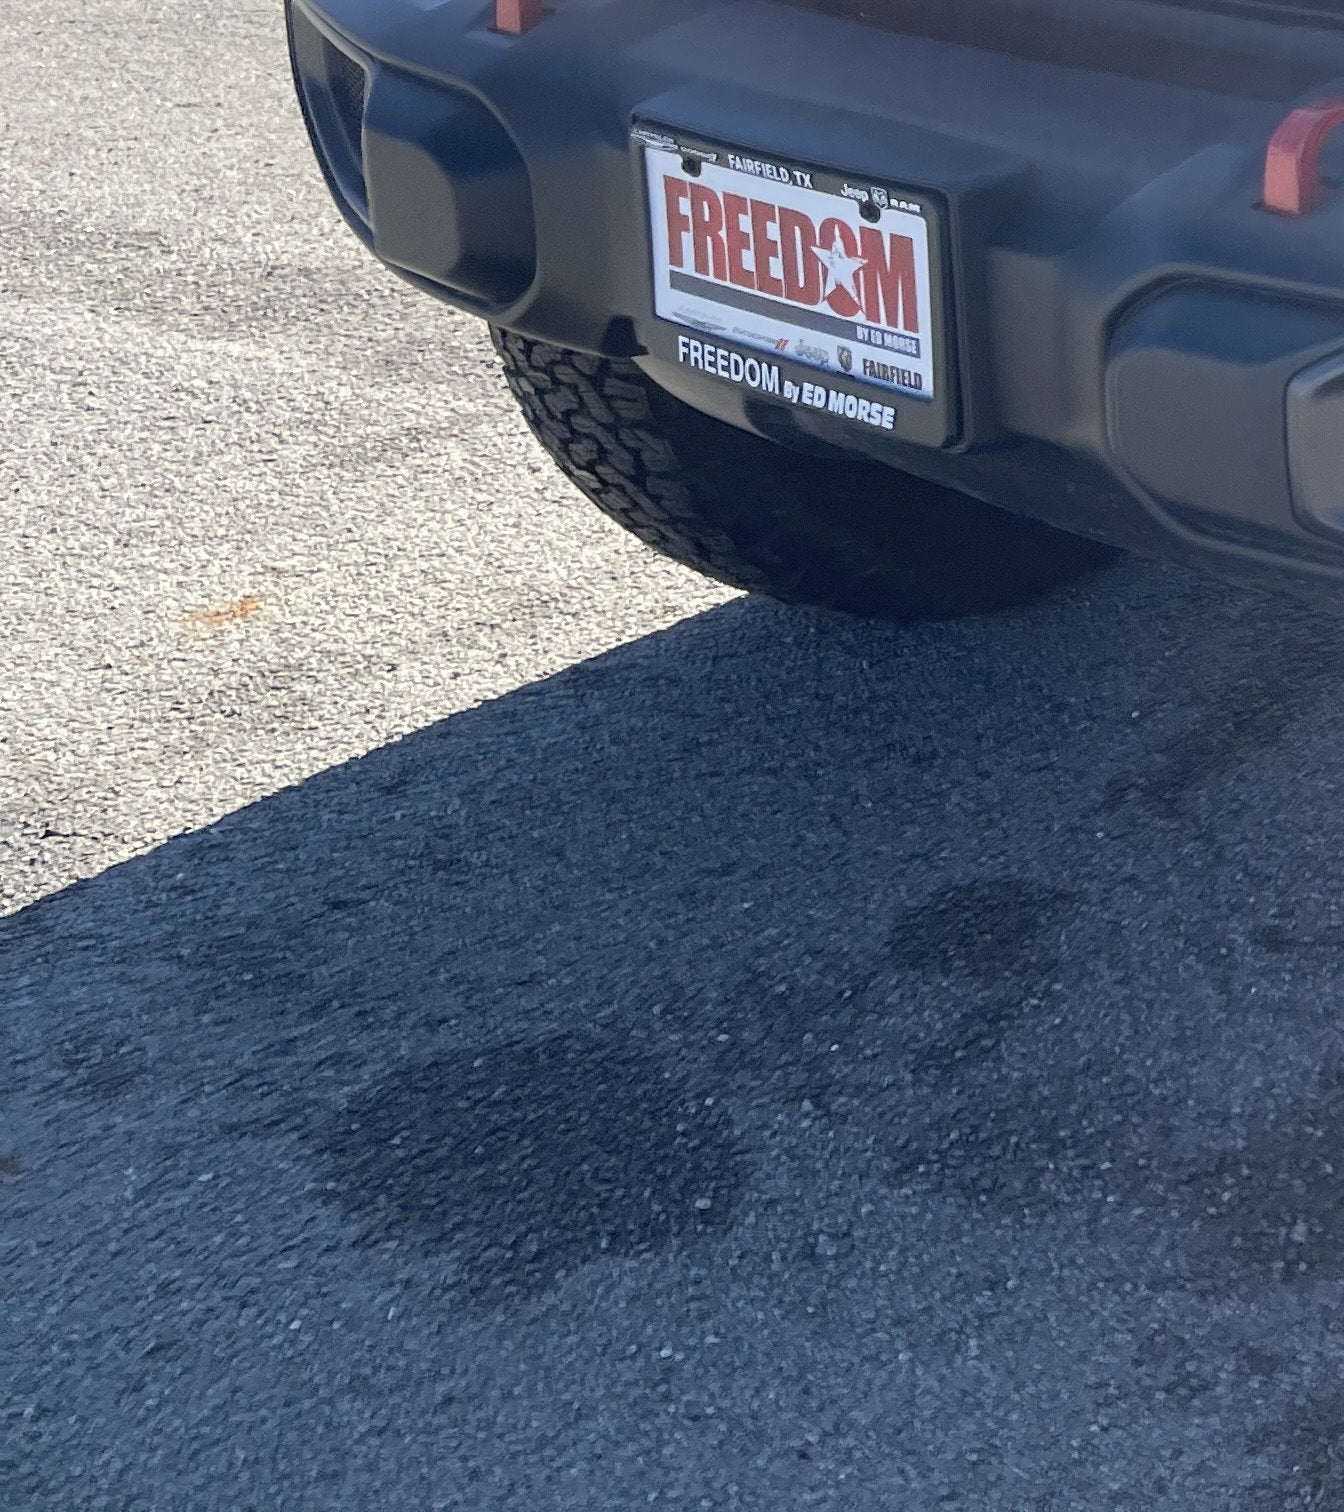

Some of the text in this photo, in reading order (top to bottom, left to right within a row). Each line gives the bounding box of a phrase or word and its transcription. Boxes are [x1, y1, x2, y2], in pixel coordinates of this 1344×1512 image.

[727, 153, 793, 186] FAIRFIELD,
[793, 170, 813, 189] TX
[663, 174, 920, 335] FREEDOM
[677, 335, 780, 395] FREEDOM
[801, 382, 826, 409] ED
[827, 389, 896, 430] MORSE
[862, 358, 923, 391] FAIRFIELD
